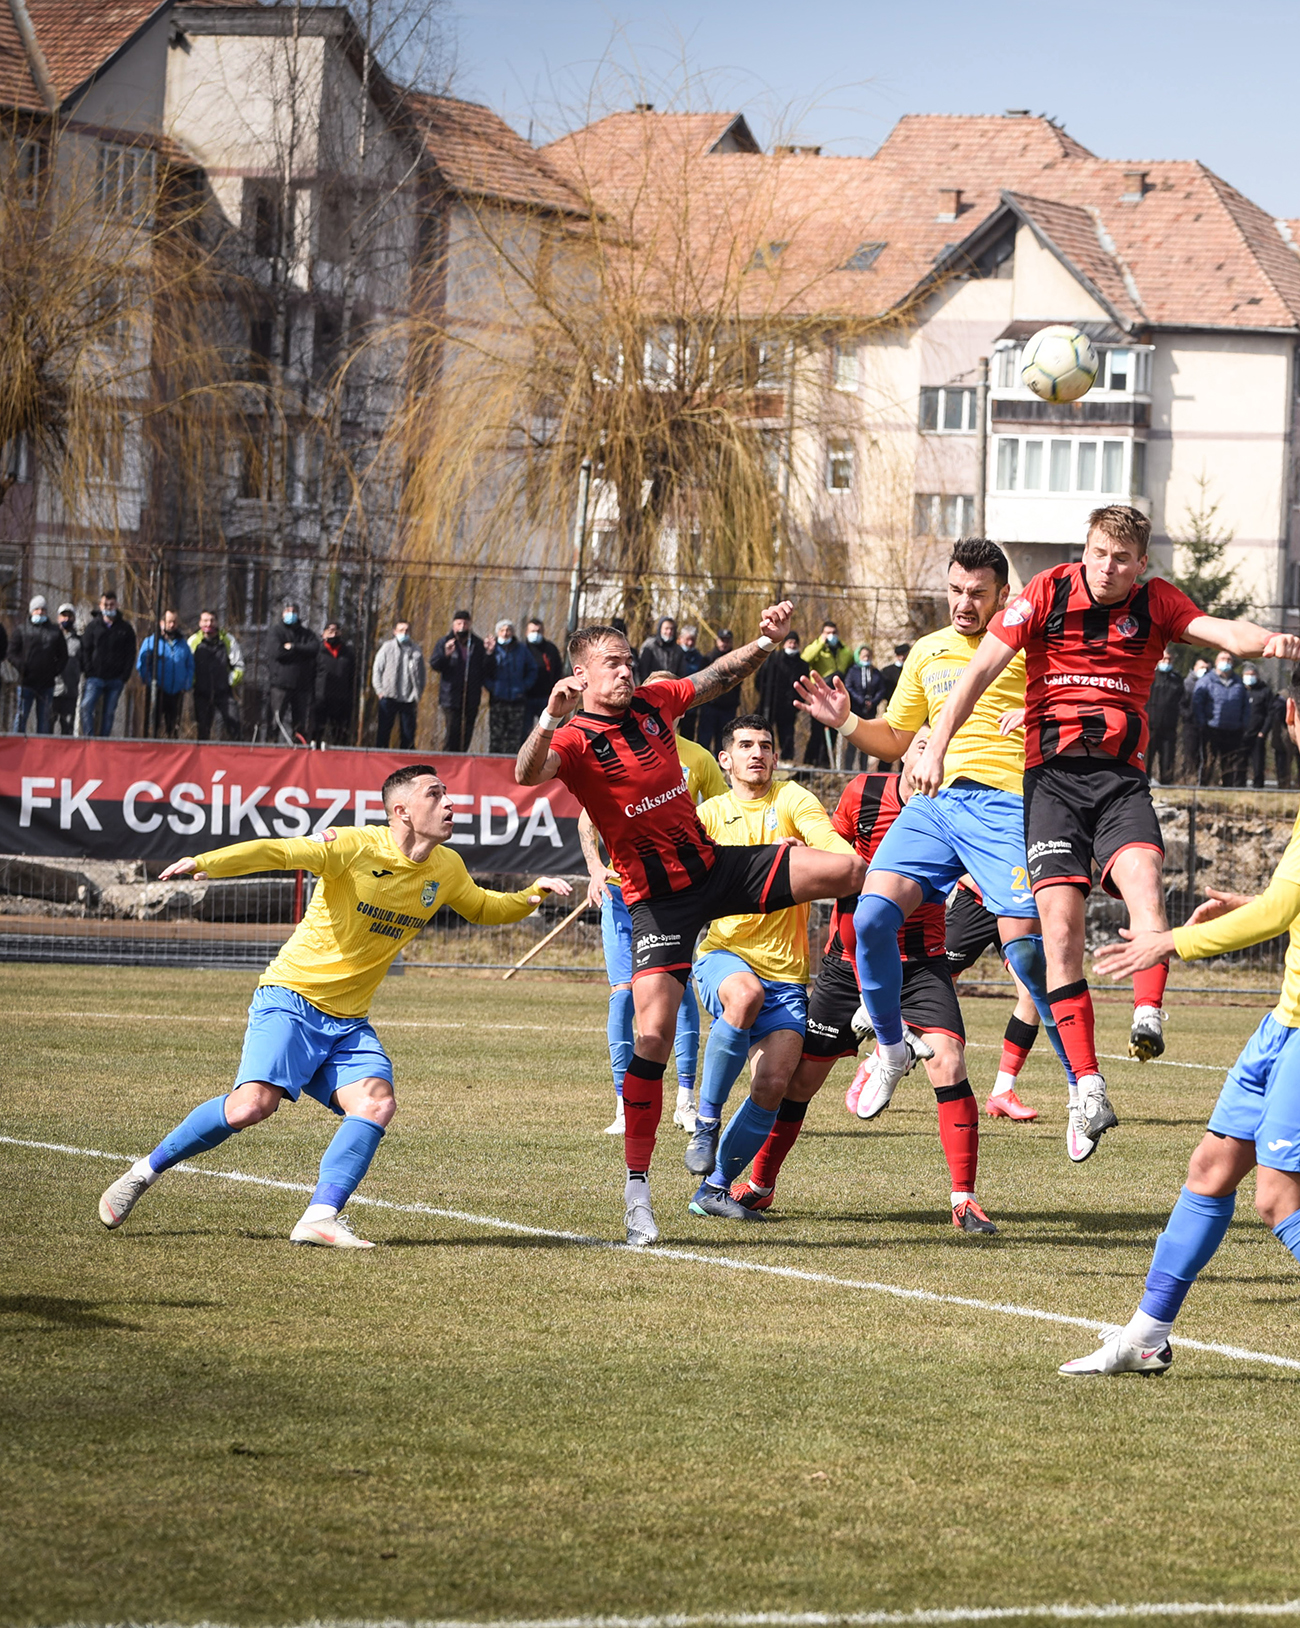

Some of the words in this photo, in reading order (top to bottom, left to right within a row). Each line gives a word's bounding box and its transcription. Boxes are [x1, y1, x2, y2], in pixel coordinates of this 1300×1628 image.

[19, 776, 103, 831] FK
[122, 769, 564, 849] CSÍKSZEEDA
[625, 779, 688, 818] Csíkszered
[1010, 865, 1031, 890] 2
[357, 901, 396, 924] CONSILIUL
